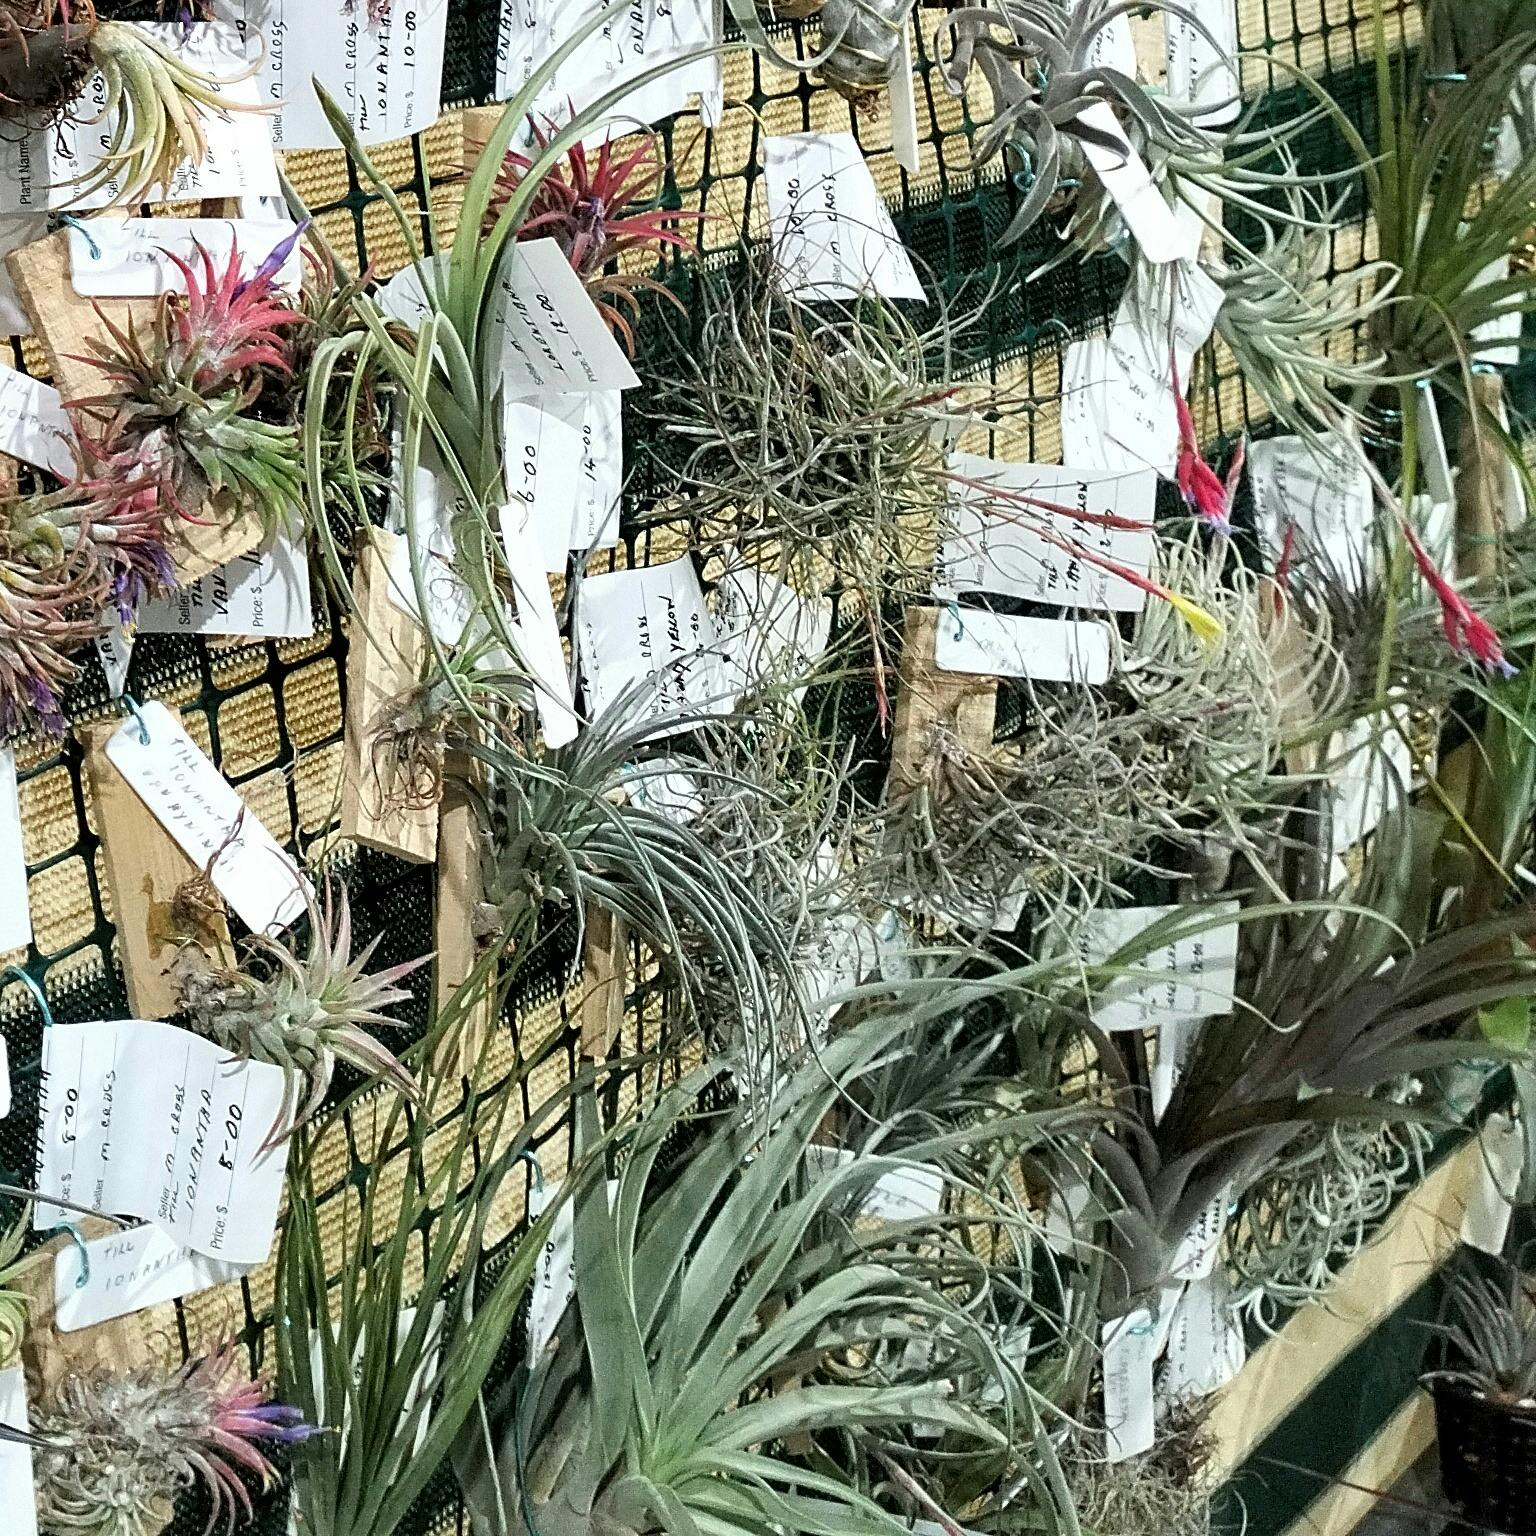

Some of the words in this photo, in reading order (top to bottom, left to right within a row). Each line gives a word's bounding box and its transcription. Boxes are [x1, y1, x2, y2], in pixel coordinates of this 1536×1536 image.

[271, 20, 287, 70] CROSS
[345, 23, 358, 69] CROSS
[404, 11, 415, 67] 10-00
[271, 83, 280, 98] M
[273, 115, 282, 142] Seller
[19, 140, 30, 170] Name
[19, 172, 32, 205] Plant
[184, 1089, 212, 1212] IONANTHA
[211, 1217, 225, 1250] Price:
[218, 1104, 243, 1170] 8-00
